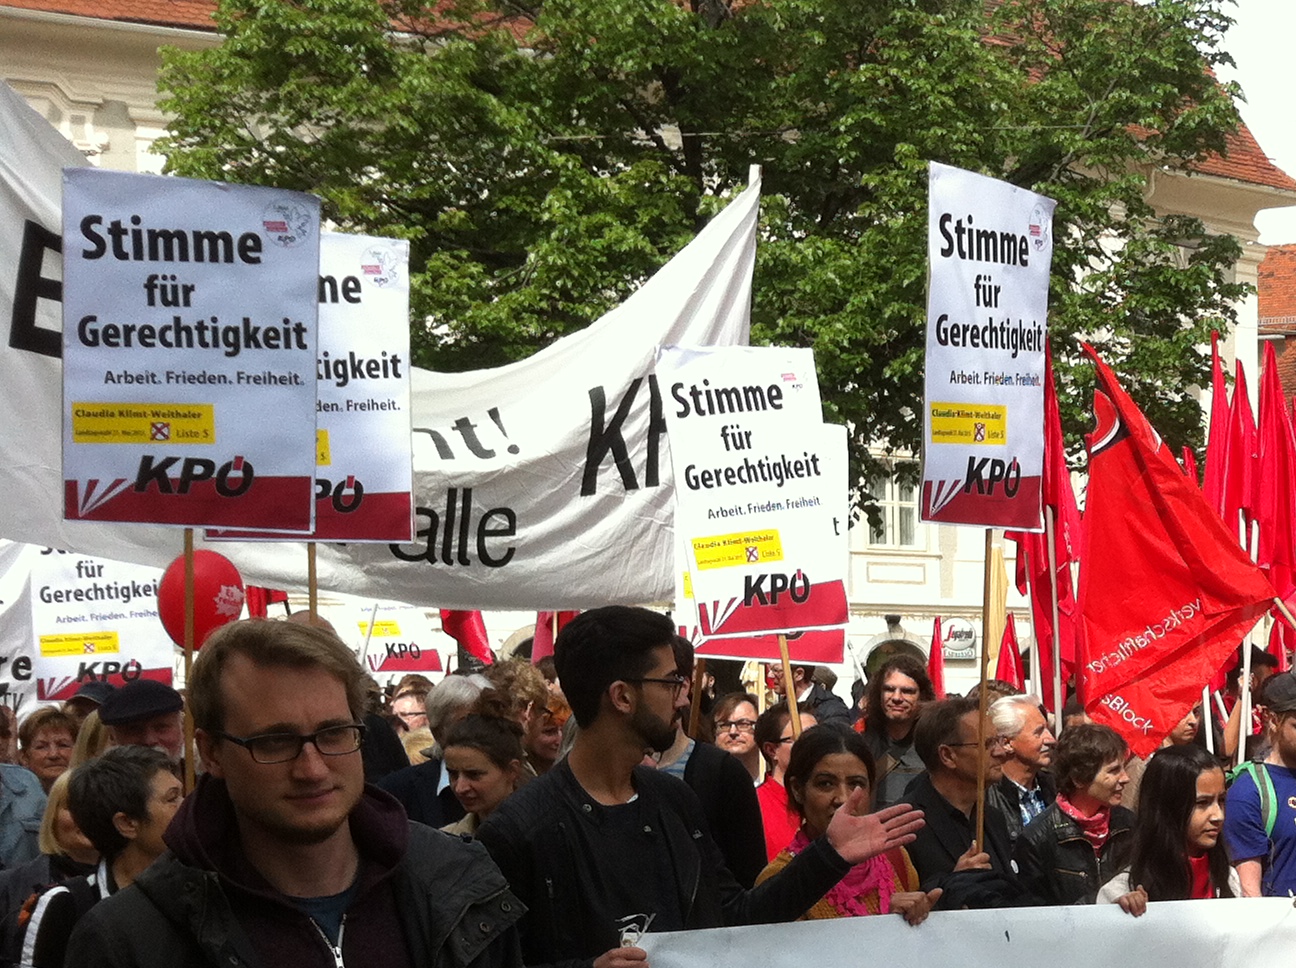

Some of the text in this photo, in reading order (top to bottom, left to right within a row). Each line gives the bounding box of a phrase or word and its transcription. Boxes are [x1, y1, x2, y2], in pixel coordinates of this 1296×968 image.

[80, 214, 263, 264] Stimme
[939, 213, 1029, 267] Stimme
[143, 274, 195, 307] für
[974, 274, 1001, 309] für
[77, 315, 308, 358] Gerechtigkeit
[935, 313, 1043, 359] Gerechtigkeit
[104, 370, 305, 386] Arbeit. Frieden. Freiheit.
[949, 370, 982, 385] Arbeit.
[983, 371, 1015, 386] Frieden.
[346, 399, 401, 412] Freiheit.
[671, 378, 783, 419] Stimme
[176, 429, 199, 439] Liste
[720, 424, 752, 452] für
[684, 451, 821, 491] Gerechtigkeit
[707, 505, 746, 519] Arbeit.
[747, 500, 785, 514] Frieden.
[75, 560, 104, 579] für
[56, 614, 88, 624] Arbeit.
